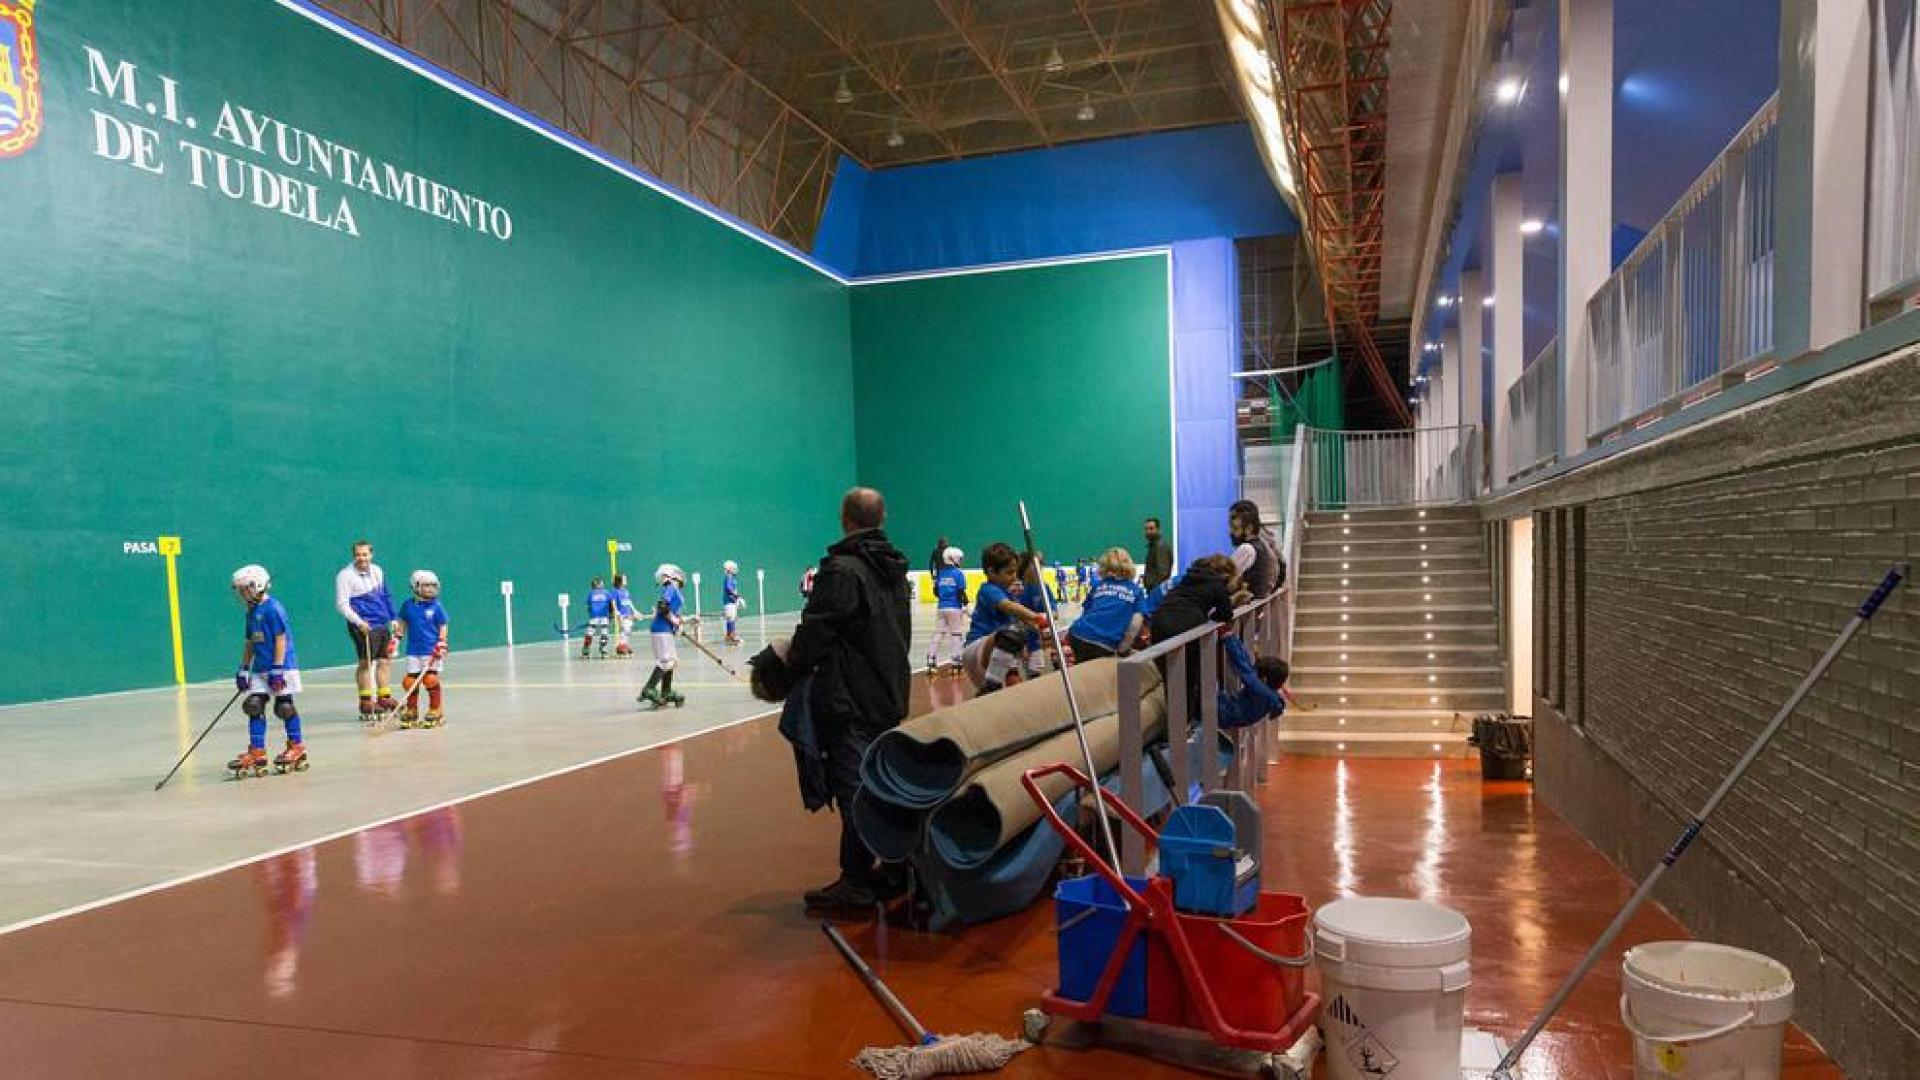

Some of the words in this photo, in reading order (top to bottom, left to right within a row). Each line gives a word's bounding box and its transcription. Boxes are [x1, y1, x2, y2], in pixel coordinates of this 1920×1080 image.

[83, 45, 197, 129] M.I.
[213, 101, 514, 240] AYUNTAMIENTO
[90, 108, 164, 175] DE
[179, 140, 360, 236] TUDELA
[123, 541, 158, 554] PASA
